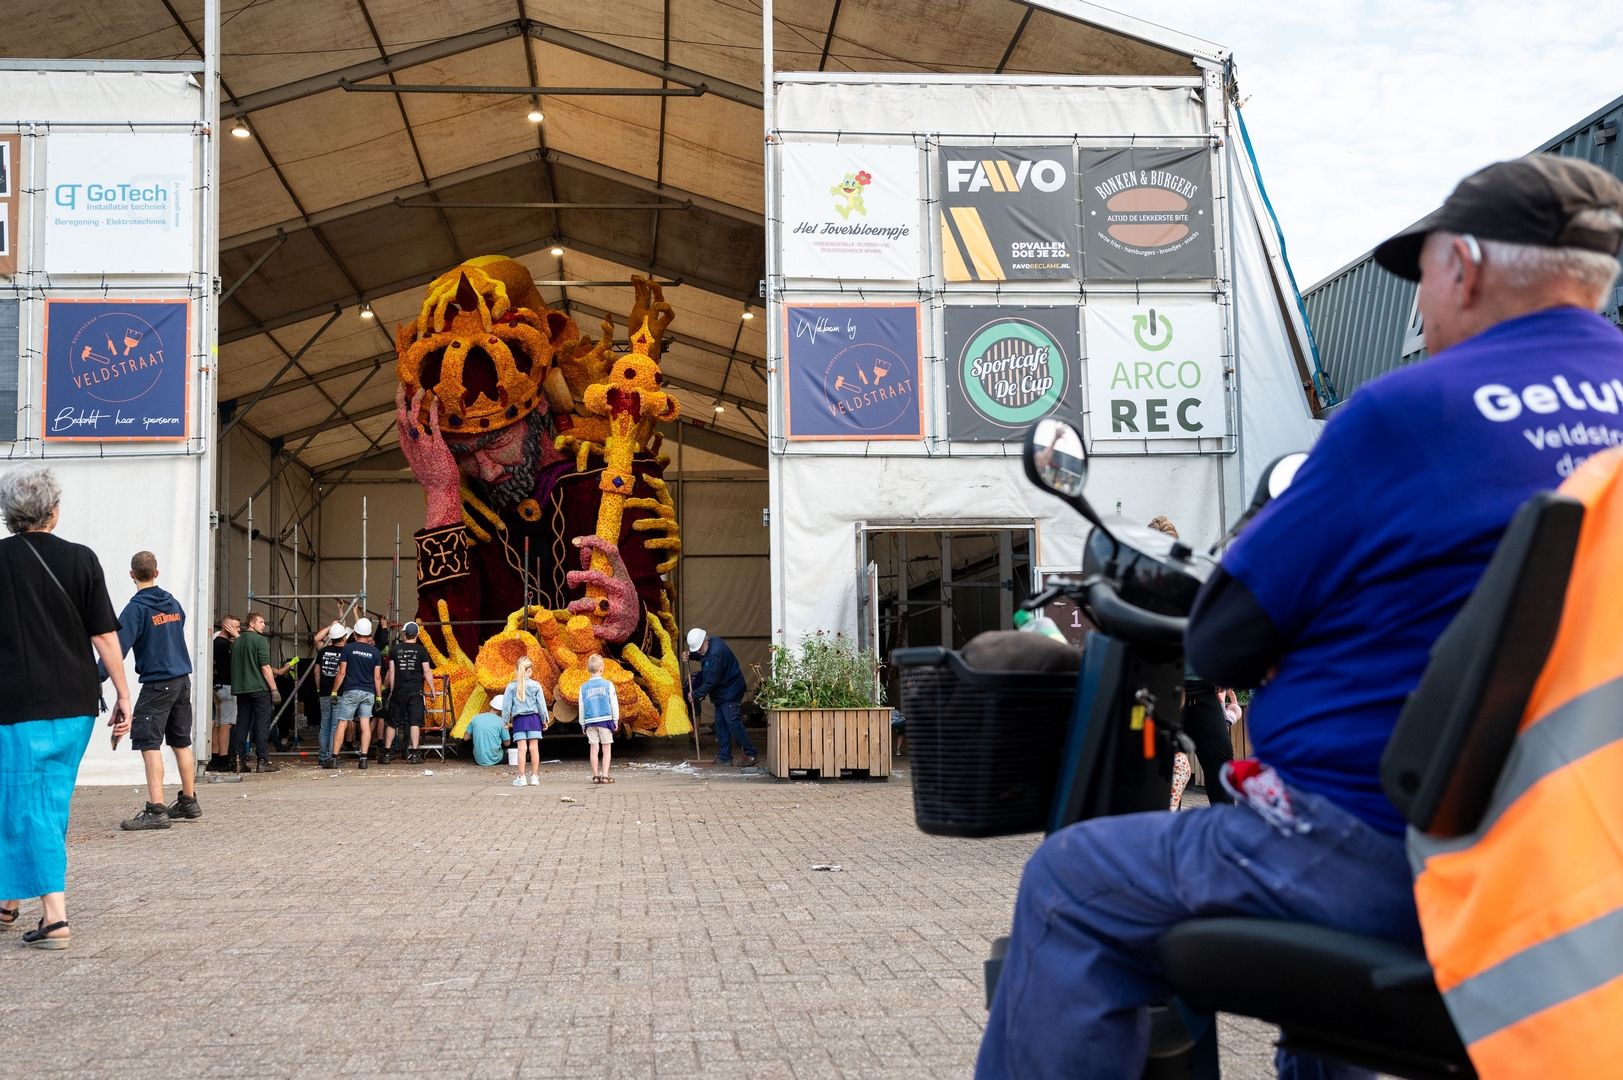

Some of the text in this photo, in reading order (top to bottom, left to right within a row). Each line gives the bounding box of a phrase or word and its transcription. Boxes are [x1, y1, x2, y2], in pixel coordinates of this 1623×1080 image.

[87, 184, 167, 201] GoTech
[1094, 170, 1198, 200] BONKEN & BURGERS
[86, 203, 167, 211] Installatie techniek
[1107, 214, 1129, 222] ALTIJD
[1129, 214, 1138, 222] DE
[1139, 214, 1174, 222] LEKKERSTE
[55, 218, 99, 227] Beregening
[106, 218, 167, 226] Elektrotechniek
[793, 222, 910, 241] Het Toverbloempje
[1011, 241, 1066, 250] OPVALLEN
[1012, 250, 1071, 258] DOE JE ZO.
[1097, 231, 1111, 243] verse
[1109, 239, 1122, 249] friet
[1124, 246, 1156, 257] hamburgers
[1159, 243, 1182, 255] broodjes
[1183, 231, 1200, 244] snacks
[71, 316, 98, 344] BUURTSCHAP
[73, 350, 165, 389] VELDSTRAAT
[970, 345, 1051, 378] Sportcafé
[994, 375, 1054, 399] De Cup
[1110, 360, 1202, 390] ARCO
[828, 379, 912, 417] VELDSTRAAT
[51, 406, 180, 432] Bedankt haar sponsoren
[1110, 397, 1204, 433] REC
[1522, 421, 1623, 450] Veldstr
[1071, 610, 1081, 627] 1
